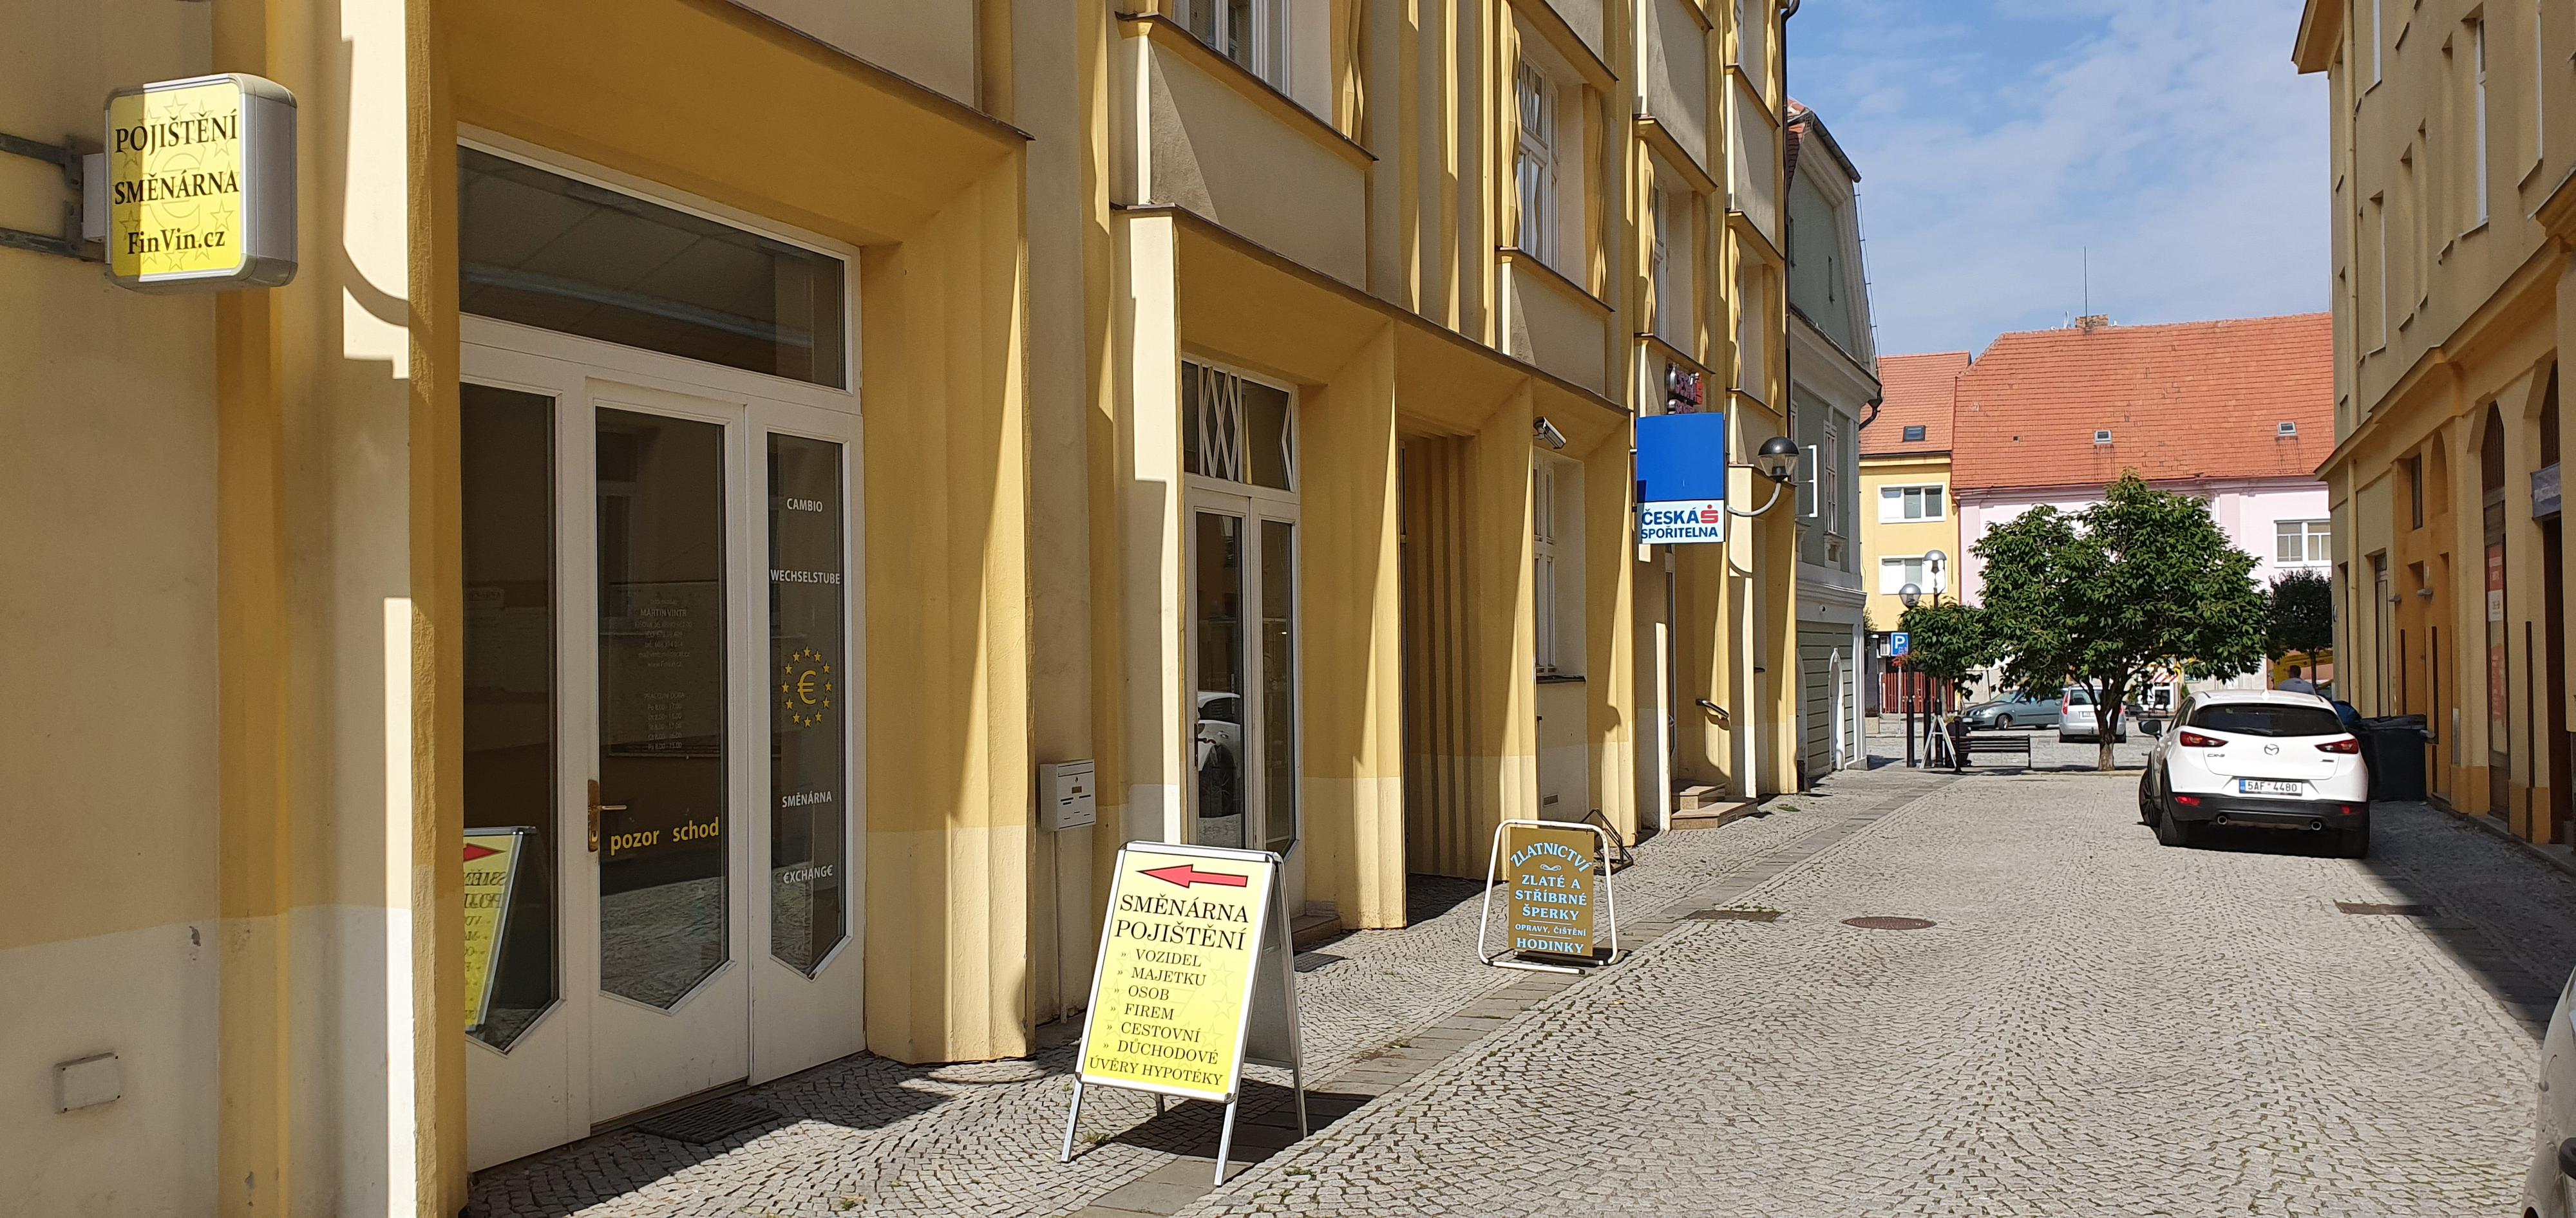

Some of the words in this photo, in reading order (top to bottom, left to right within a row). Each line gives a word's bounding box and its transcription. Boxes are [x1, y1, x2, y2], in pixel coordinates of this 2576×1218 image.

[115, 108, 238, 156] POJIŠTĚNÍ
[114, 169, 239, 205] SMĚNÁRNA
[127, 228, 225, 254] FinVin.cz
[786, 498, 823, 512] CAMBIO
[1642, 507, 1700, 525] ČESKÁ
[1642, 525, 1718, 539] SPOŘITELNA
[770, 568, 840, 585] WECHSELSTUBE
[1895, 635, 1906, 649] P
[2248, 781, 2266, 791] 5AF
[2273, 782, 2297, 792] 4480
[782, 791, 832, 808] SMĚNÁRNA
[611, 830, 660, 856] pozor
[672, 816, 719, 842] schod
[1510, 842, 1593, 872] ZLATNICTVÍ
[1521, 874, 1566, 888] ZLATÉ
[1571, 878, 1581, 889] A
[1515, 888, 1587, 906] STŘÍBRNÉ
[1120, 893, 1249, 923] SMĚNÁRNA
[1522, 904, 1579, 921] ŠPERKY
[1114, 919, 1247, 951] POJIŠTĚNÍ
[1515, 924, 1550, 933] OPRAVY,
[1553, 926, 1586, 936] ČIŠTĚNÍ
[1516, 937, 1584, 953] HODINKY
[1135, 949, 1202, 967] VOZIDEL
[1131, 967, 1206, 986] MAJETKU
[1128, 985, 1170, 1000] OSOB
[1124, 1004, 1174, 1020] FIREM
[1121, 1022, 1201, 1043] CESTOVNÍ
[1117, 1038, 1218, 1065] DŮCHODOVÉ
[1090, 1057, 1139, 1074] ÚVĚRY
[1142, 1065, 1224, 1086] HYPOTÉKY
